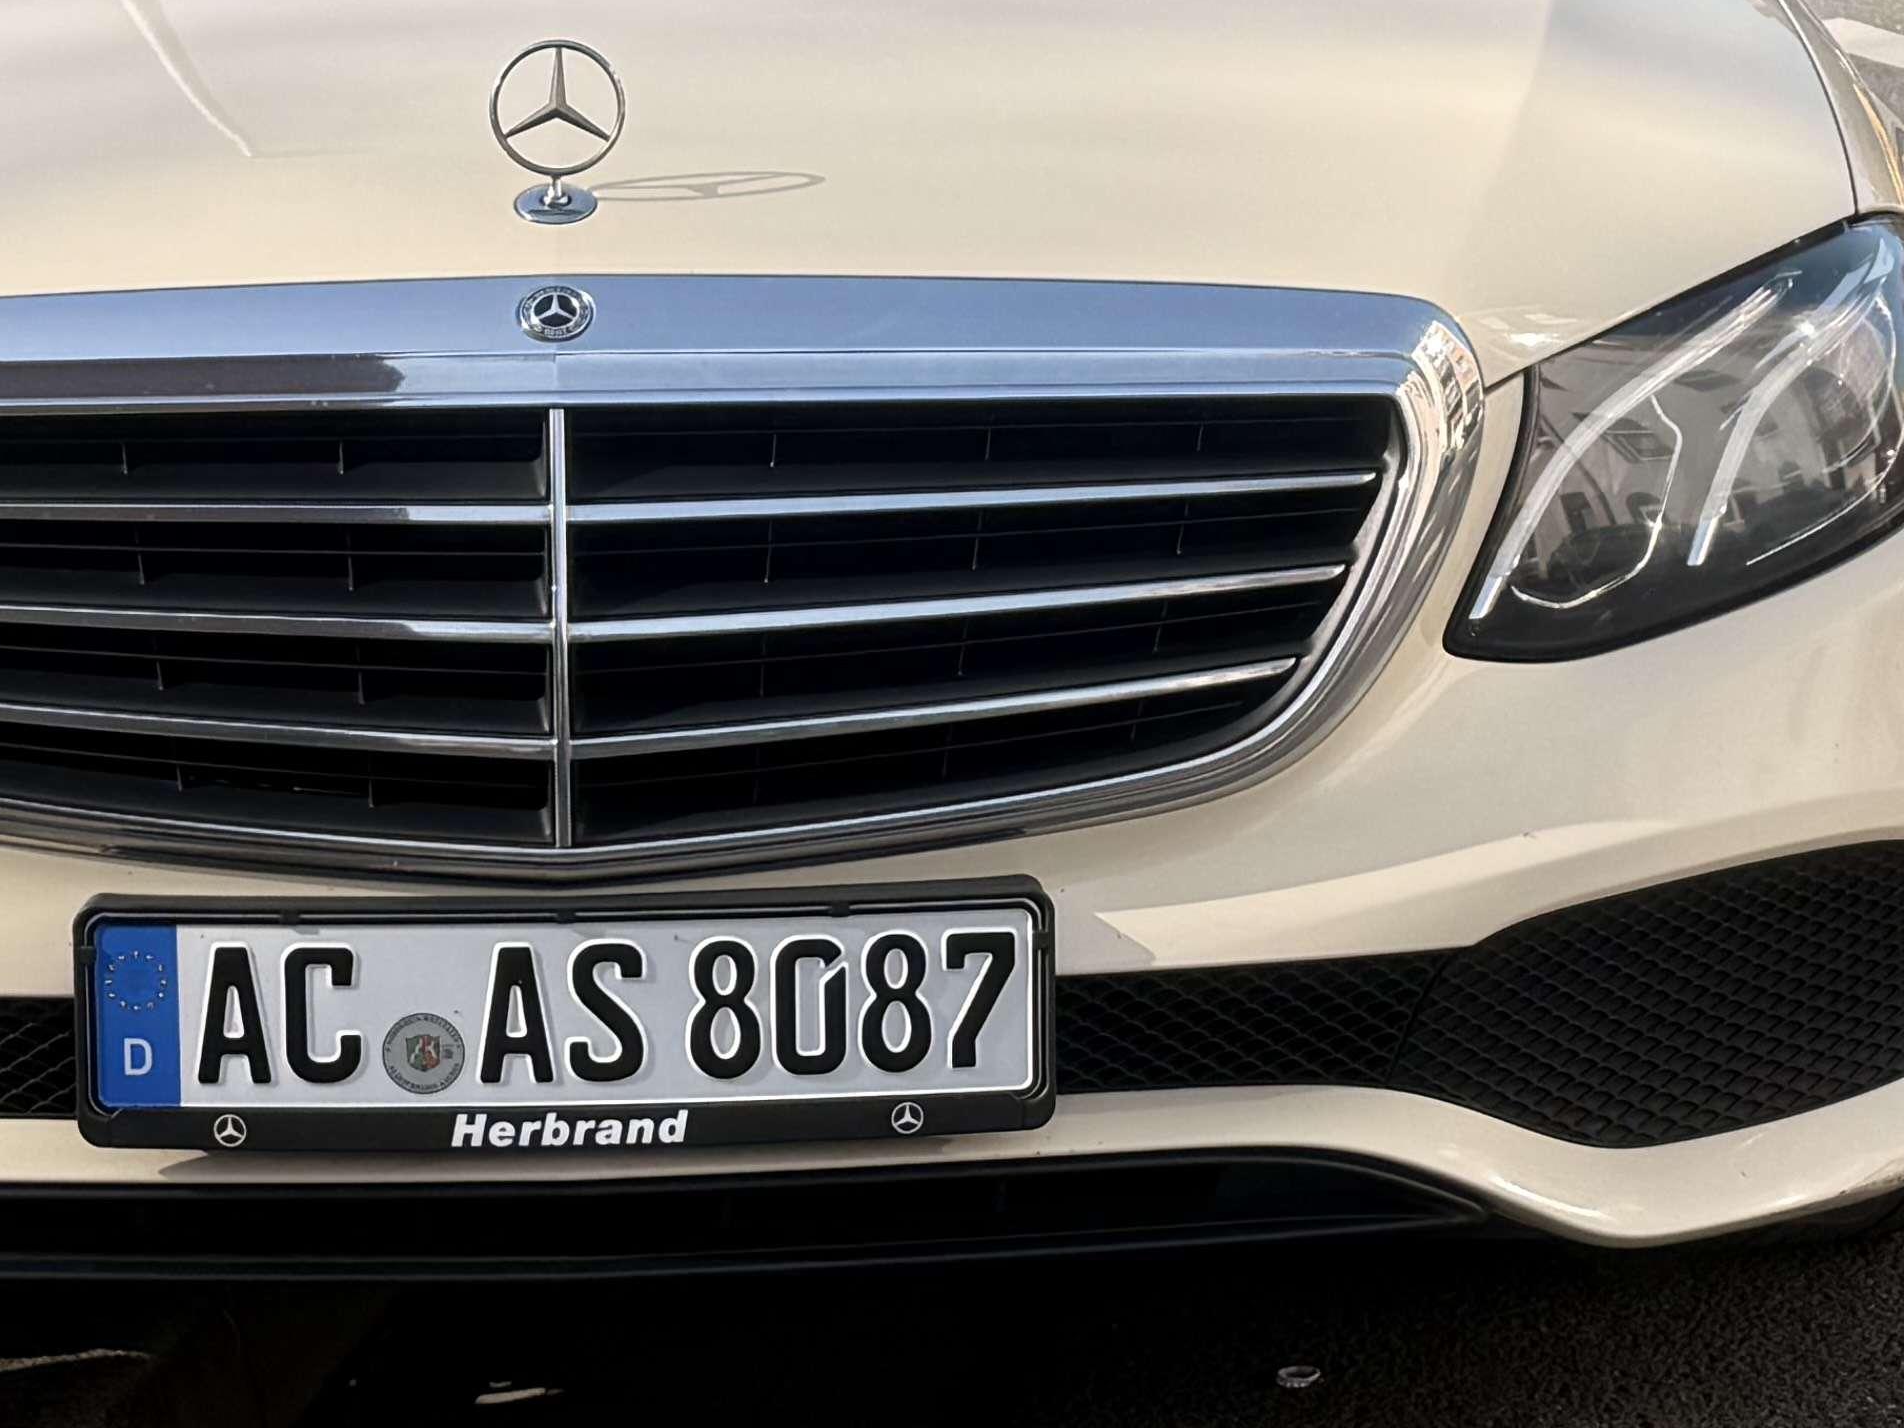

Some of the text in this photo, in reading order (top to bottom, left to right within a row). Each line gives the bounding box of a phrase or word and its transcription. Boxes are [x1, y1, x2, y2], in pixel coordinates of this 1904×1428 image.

[197, 945, 363, 1085] AC
[479, 942, 646, 1084] AS
[688, 929, 1017, 1081] 8087
[123, 1037, 154, 1076] D
[450, 1109, 689, 1148] Herbrand
